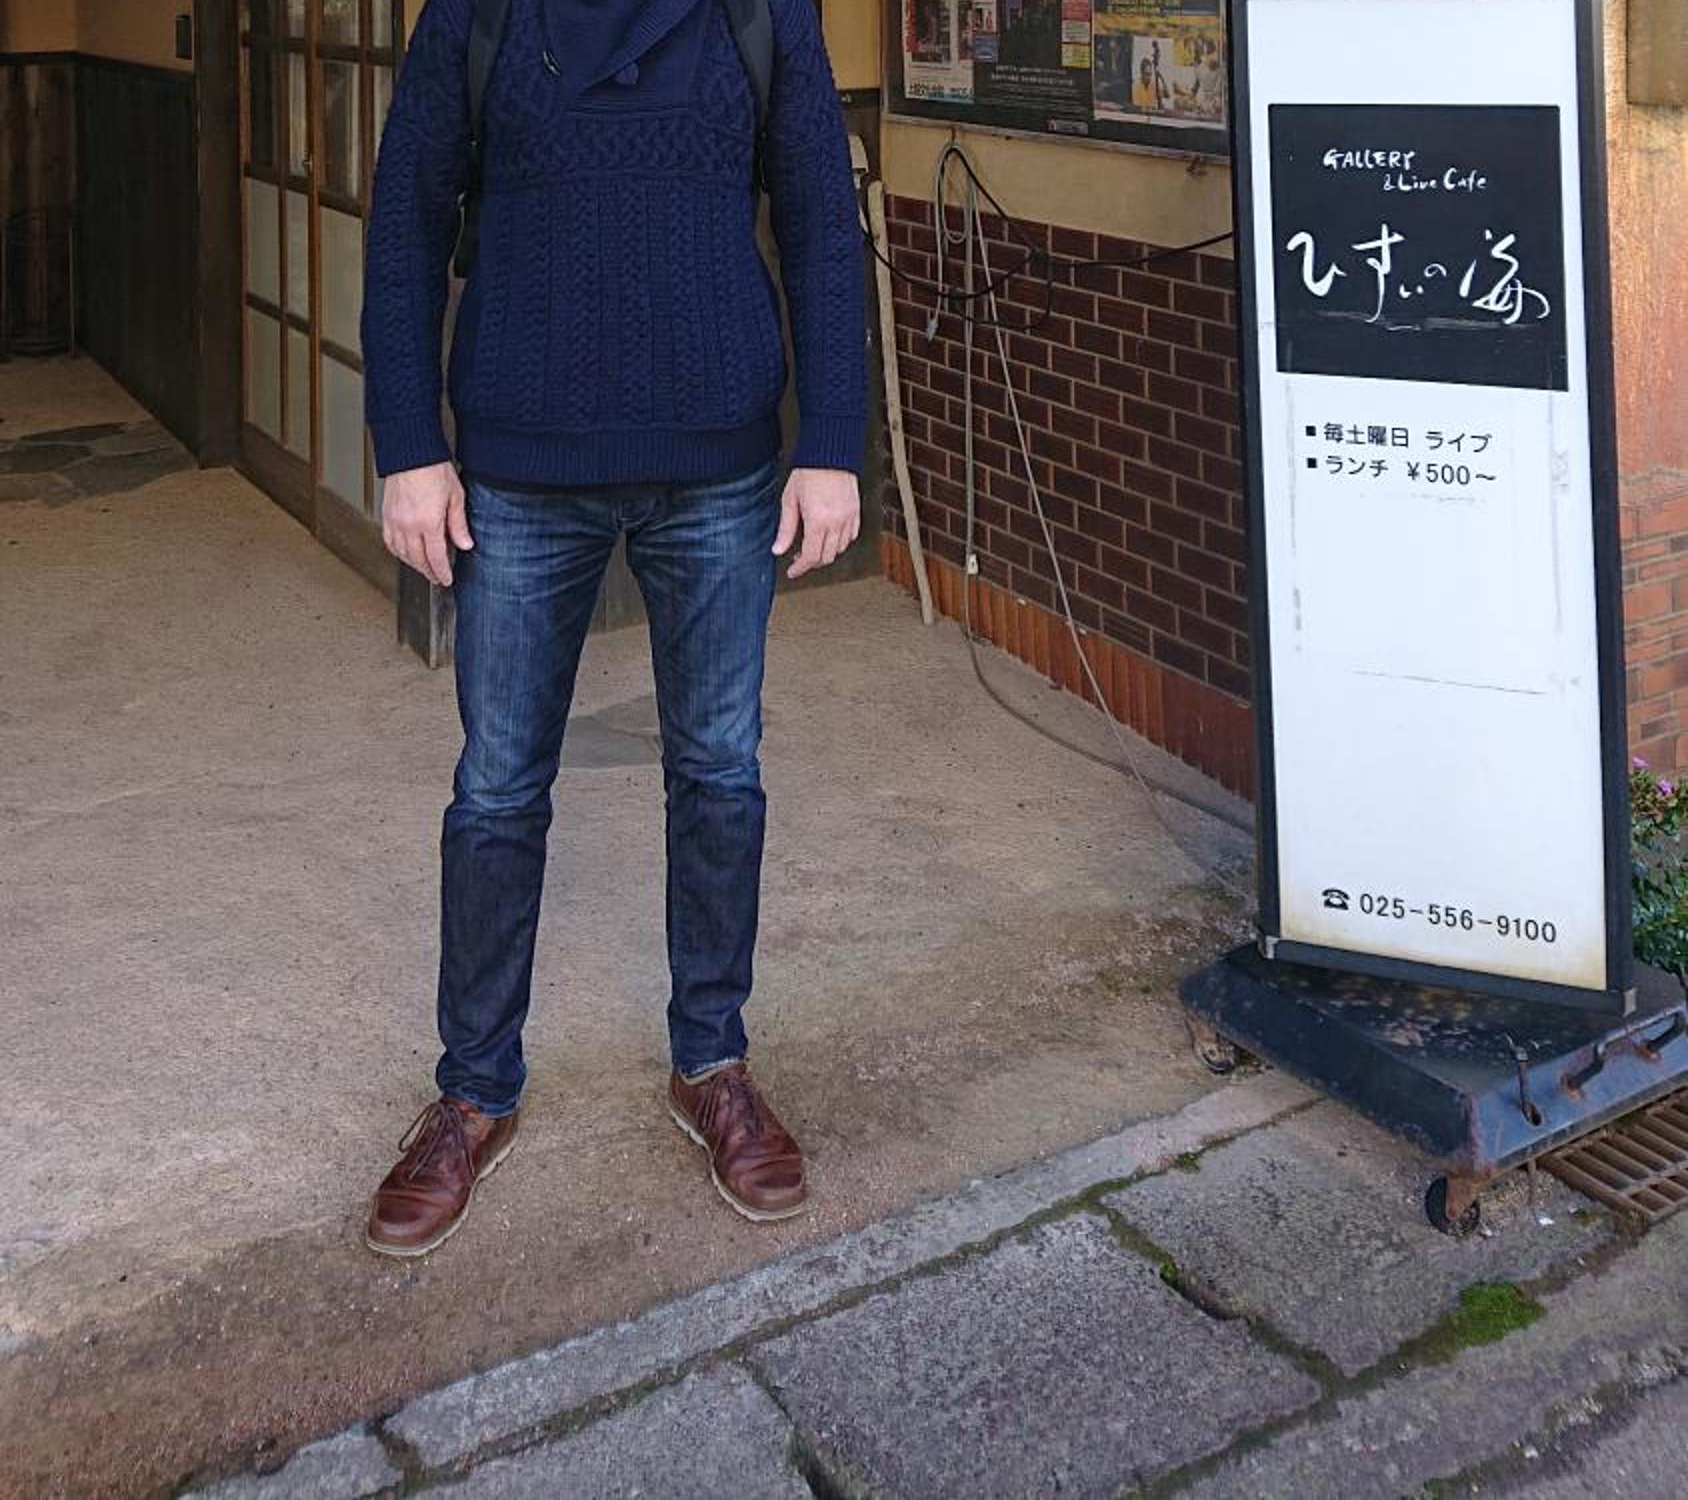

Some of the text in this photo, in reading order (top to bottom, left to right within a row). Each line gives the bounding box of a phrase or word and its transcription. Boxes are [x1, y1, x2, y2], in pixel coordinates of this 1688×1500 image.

[1322, 148, 1416, 171] GALLERY
[1443, 167, 1488, 192] Cafe
[1286, 222, 1552, 326] ひすいの海
[1323, 422, 1493, 453] 毎土曜日 ライブ
[1325, 455, 1389, 478] ランチ
[1359, 893, 1557, 943] 025-556-9100
